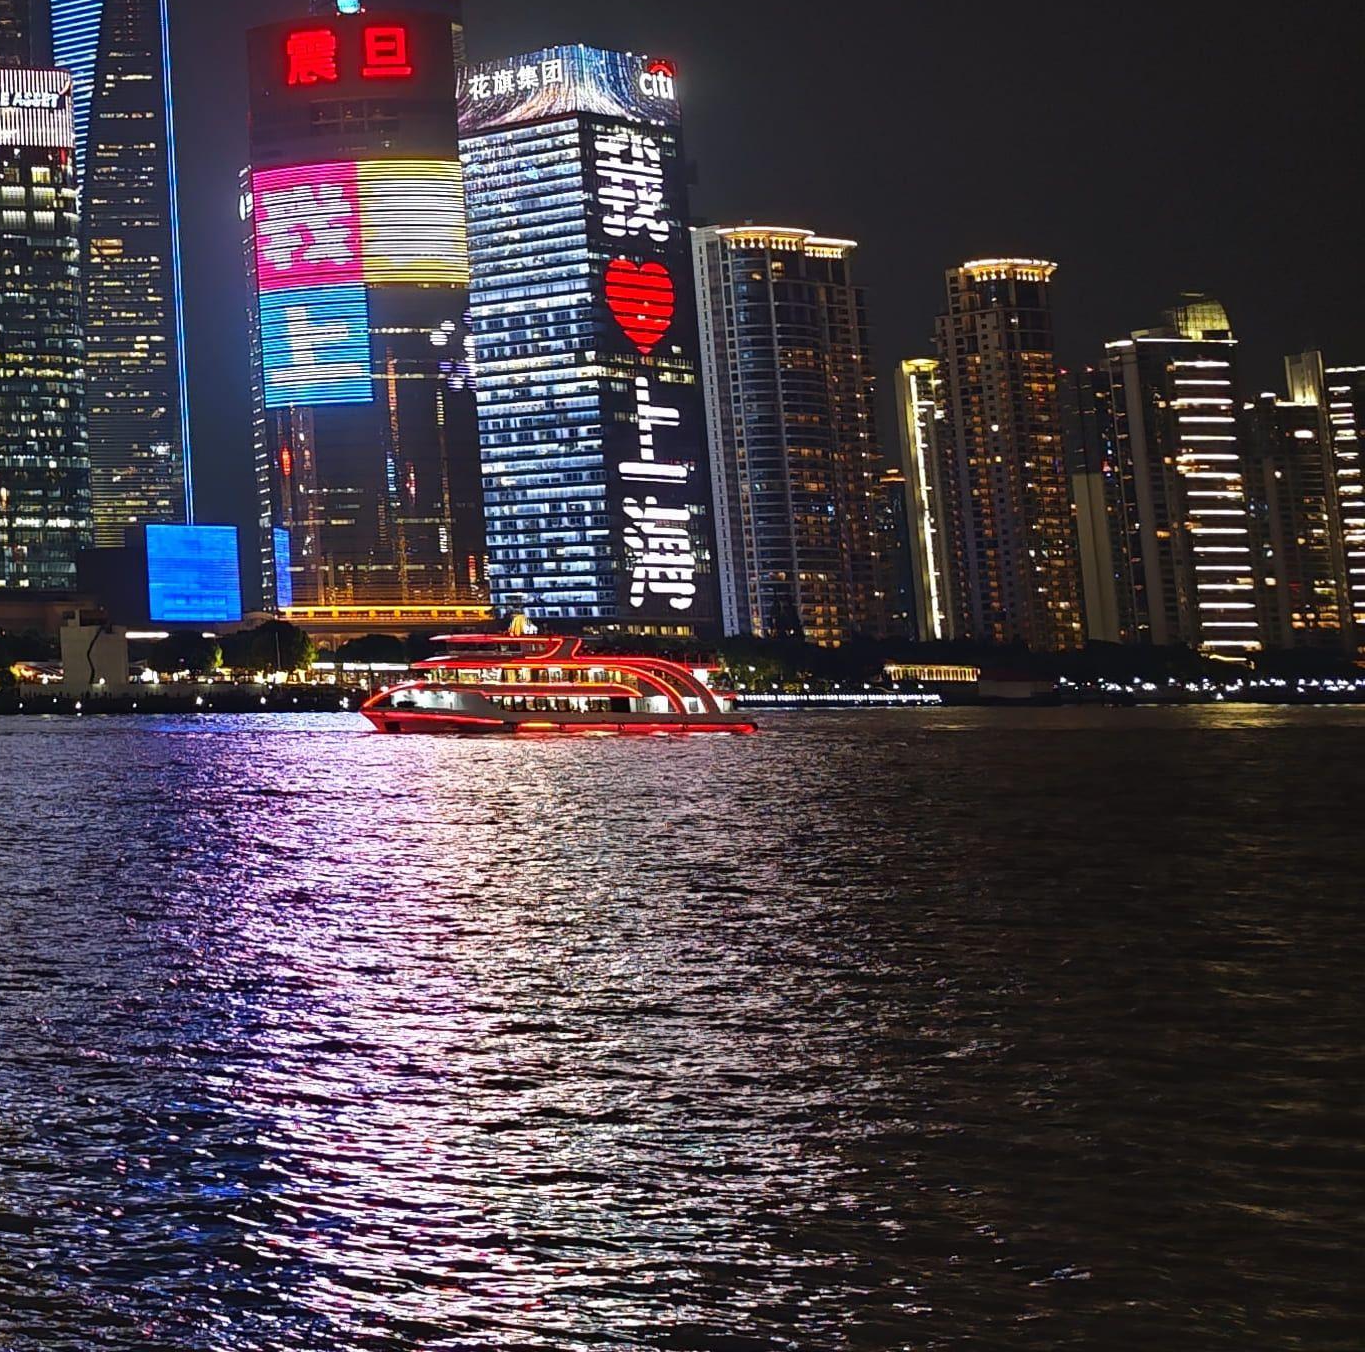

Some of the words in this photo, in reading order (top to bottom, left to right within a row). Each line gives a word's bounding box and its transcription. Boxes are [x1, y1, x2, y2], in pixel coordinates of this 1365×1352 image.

[287, 28, 412, 85] 震旦
[13, 91, 60, 108] ASSET
[468, 58, 564, 101] 花旗集团
[639, 71, 675, 100] citi
[270, 305, 365, 388] 上
